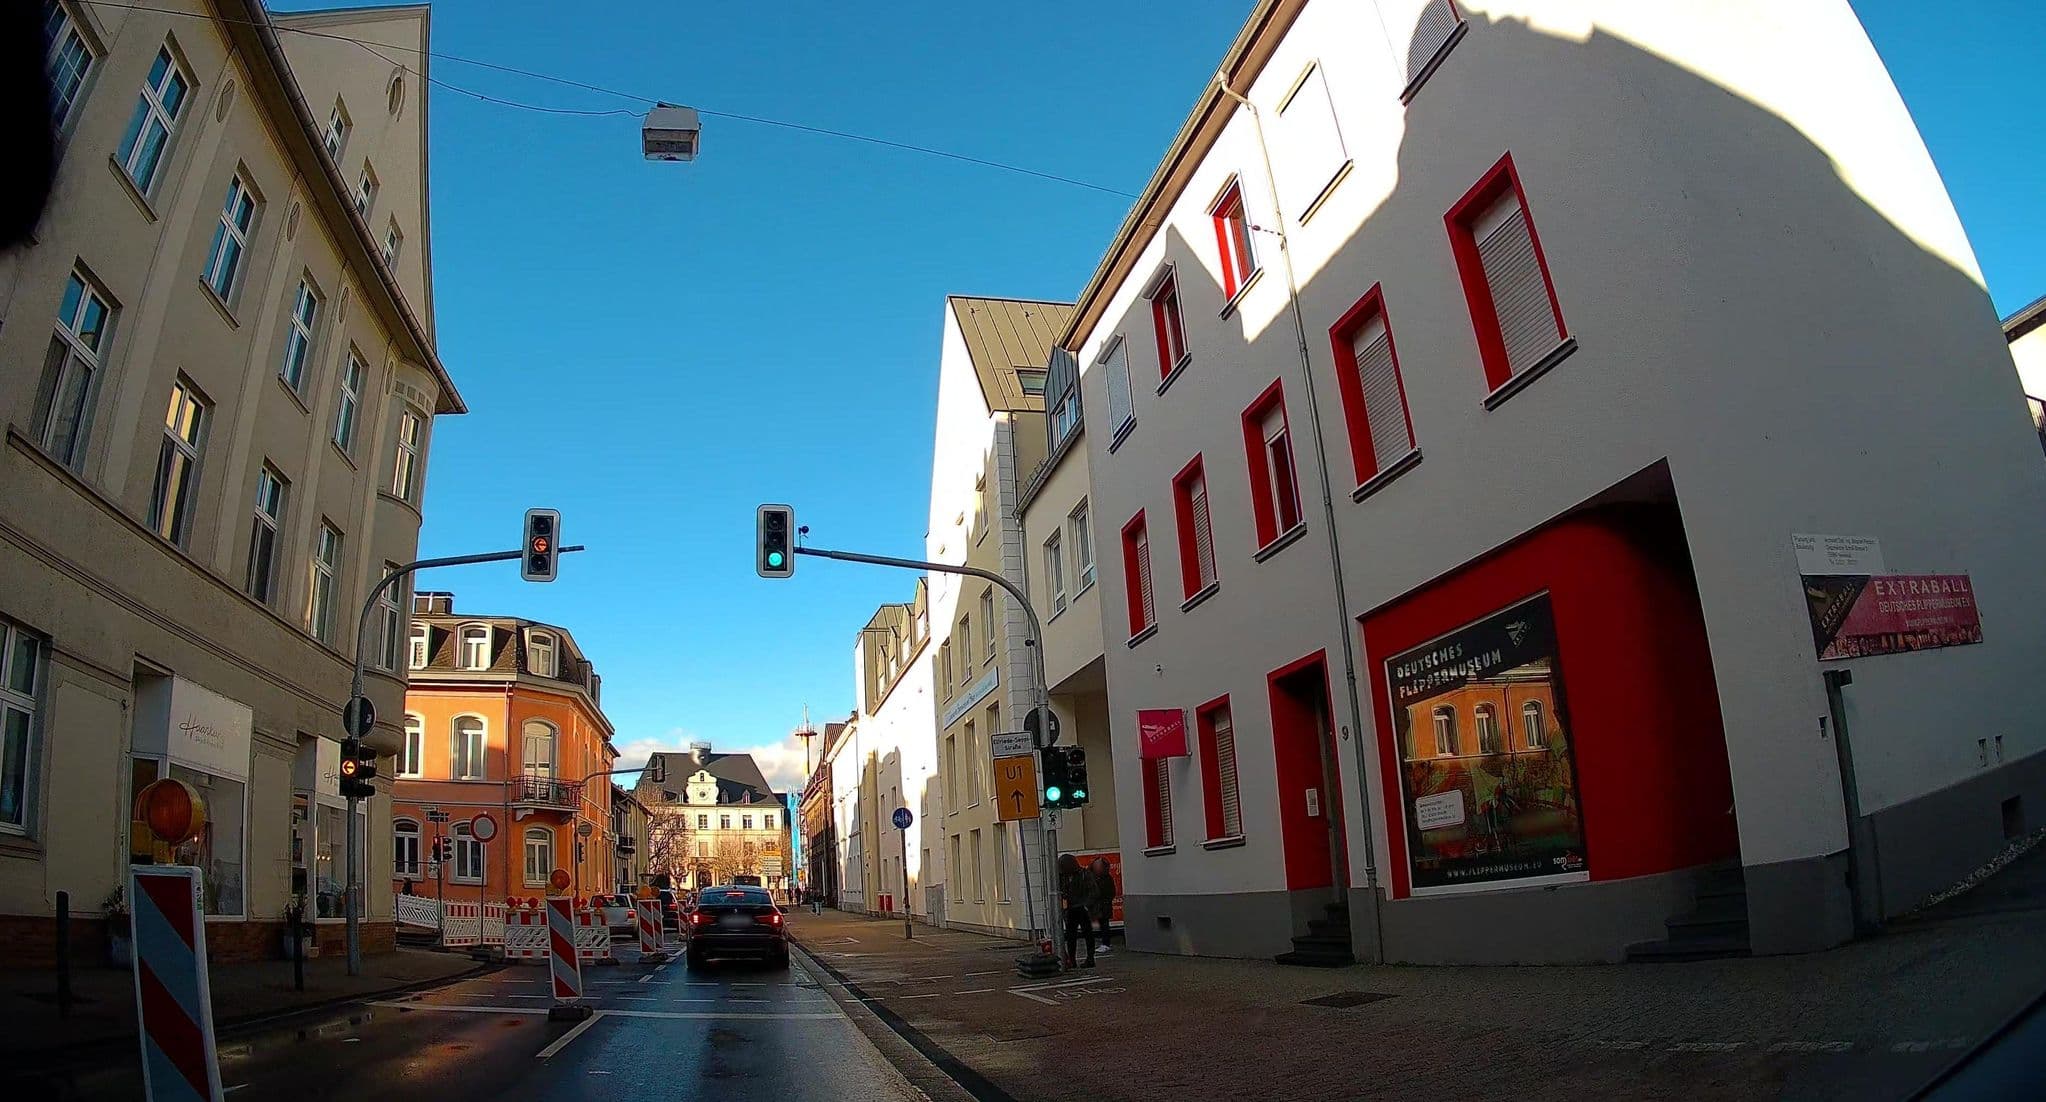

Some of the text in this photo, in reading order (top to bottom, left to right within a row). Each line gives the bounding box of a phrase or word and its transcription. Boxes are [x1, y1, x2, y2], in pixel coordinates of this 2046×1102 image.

[1875, 579, 1969, 597] EXTRABALL
[1396, 643, 1463, 679] DEUTSCHES
[1398, 648, 1502, 699] FLIPPERMUSEUM
[1342, 725, 1349, 741] 9
[1006, 765, 1023, 780] U1
